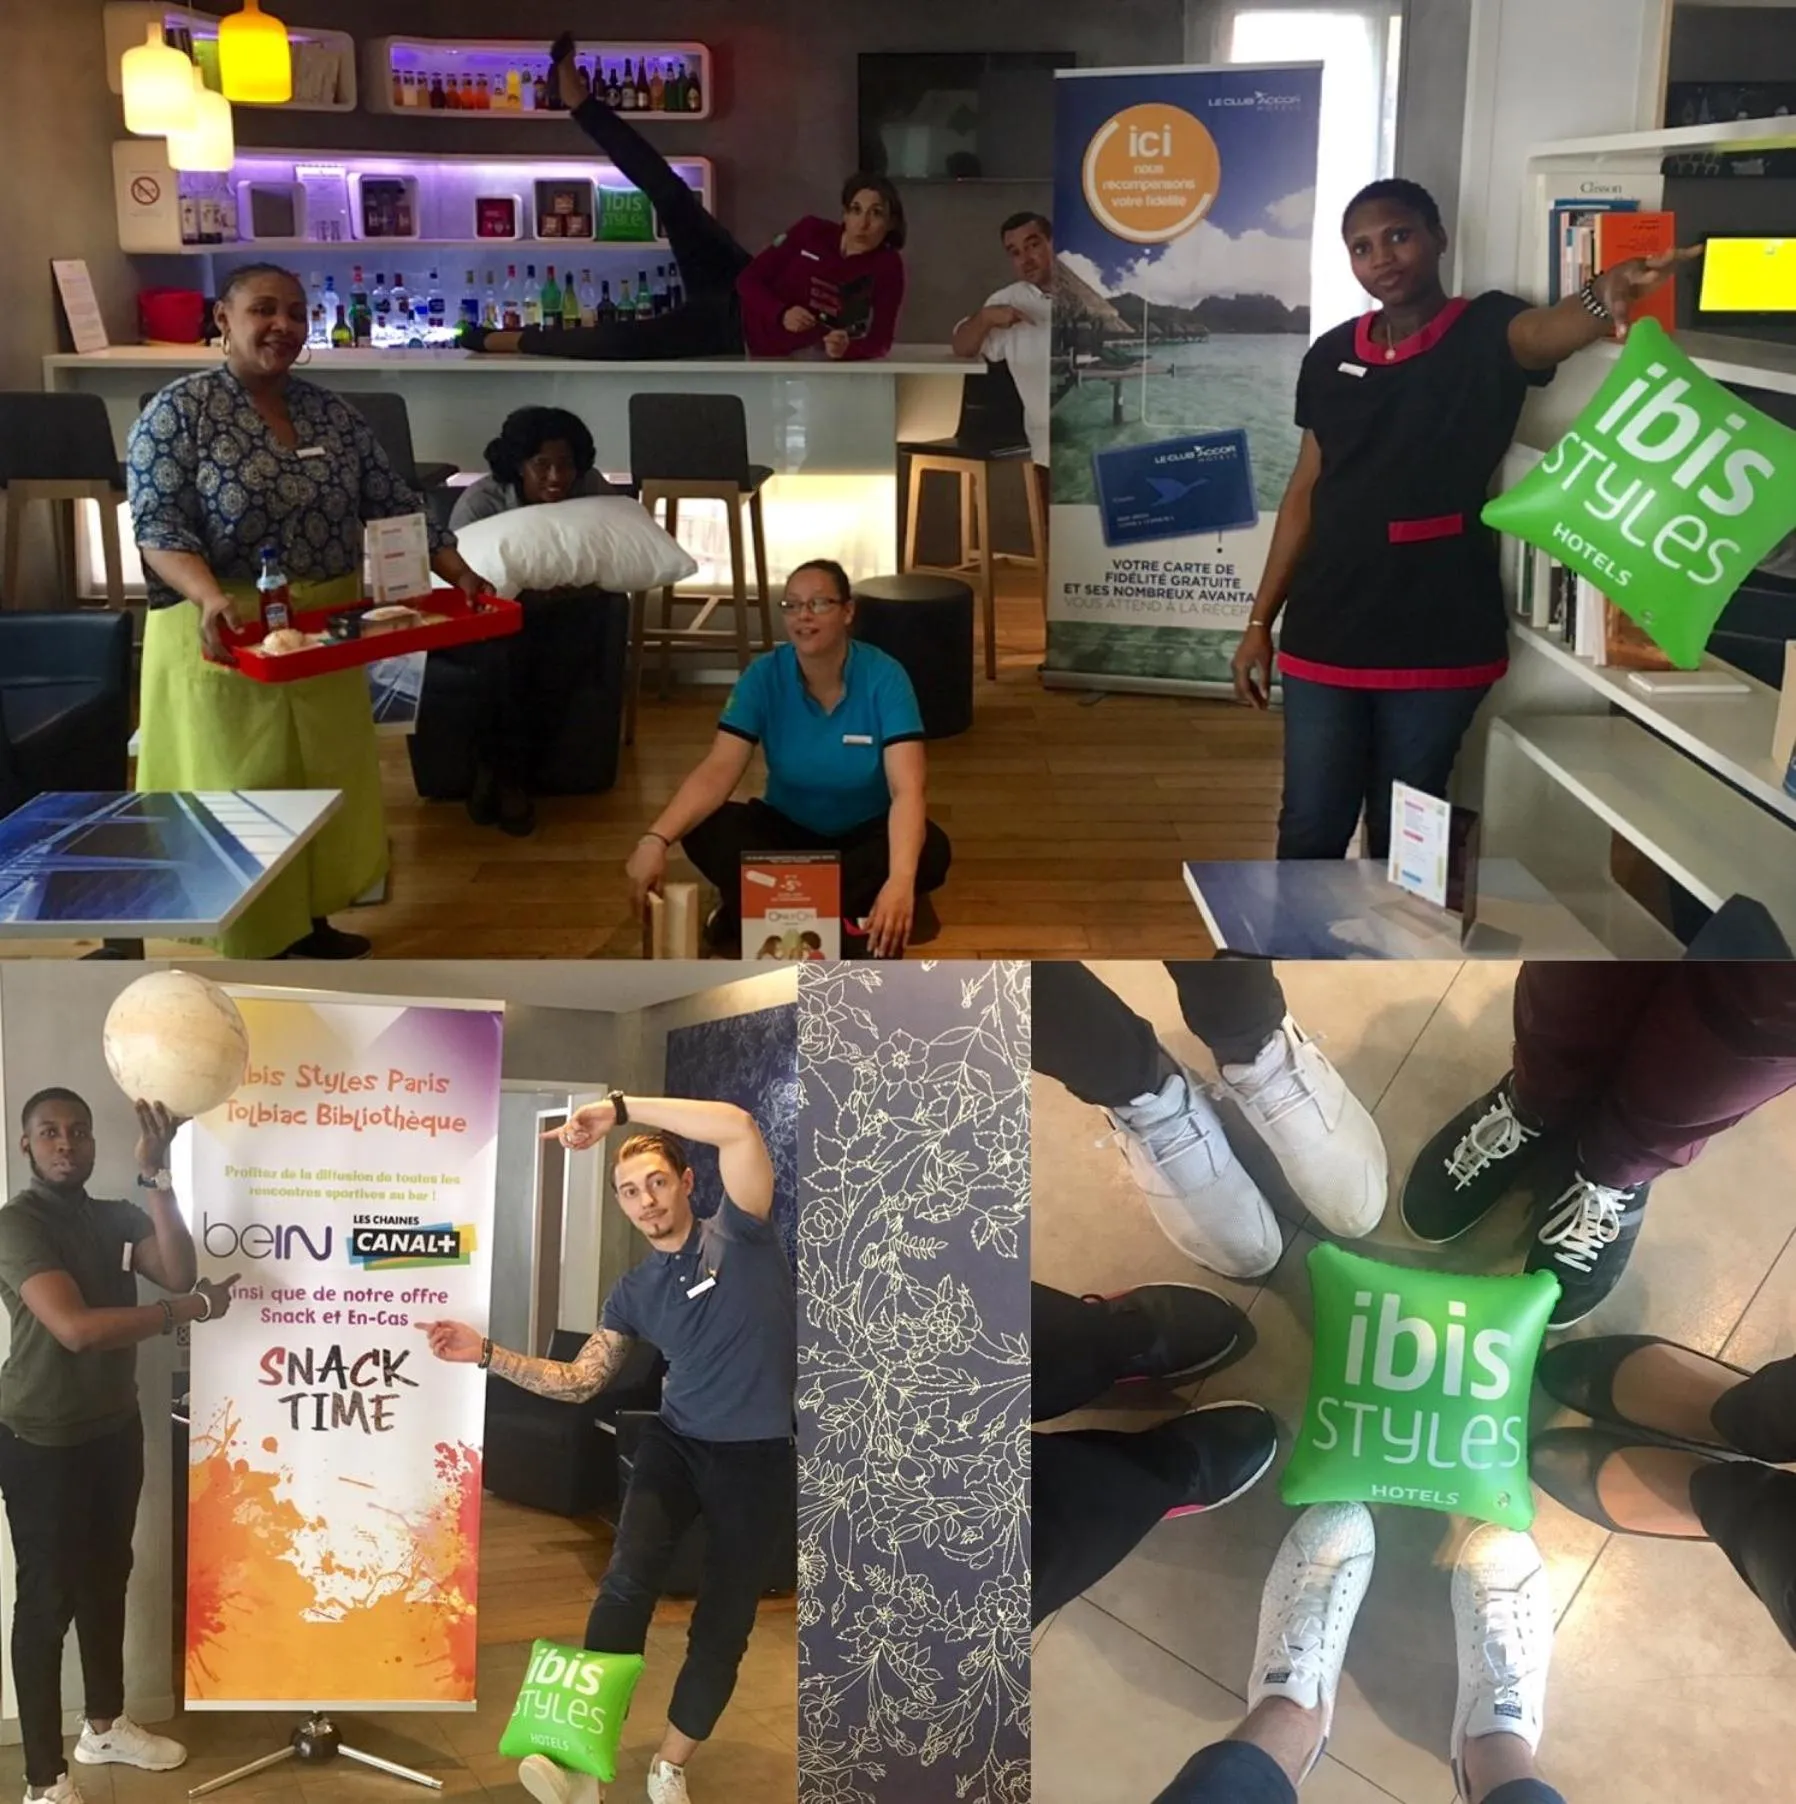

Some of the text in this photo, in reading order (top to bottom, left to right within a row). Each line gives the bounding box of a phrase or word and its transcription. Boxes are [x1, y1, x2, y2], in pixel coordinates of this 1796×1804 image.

[1129, 123, 1172, 158] ici
[1133, 164, 1164, 175] nous
[1111, 195, 1144, 208] votre
[1594, 362, 1776, 517] ibis
[1552, 521, 1633, 587] HOTELS
[1112, 559, 1235, 576] VOTRE CARTE DE
[1170, 574, 1241, 589] GRATUITE
[1063, 583, 1257, 603] ET SES NOMBREUX AVANTA
[1064, 596, 1103, 609] VOUS
[1105, 598, 1162, 613] ATTEND
[1179, 603, 1200, 615] LA
[296, 1064, 378, 1094] Styles
[387, 1069, 449, 1094] Paris
[226, 1099, 467, 1137] Tolbiac Bibliothèque
[281, 1168, 296, 1179] de
[300, 1168, 312, 1180] la
[316, 1168, 373, 1182] diffusion
[376, 1171, 392, 1183] de
[396, 1172, 437, 1184] toutes
[441, 1173, 460, 1184] les
[249, 1186, 321, 1198] rencontres
[325, 1188, 386, 1200] sportives
[389, 1190, 405, 1200] au
[408, 1189, 428, 1201] bar
[353, 1215, 420, 1225] LES CHAINES
[203, 1211, 333, 1261] beIN
[356, 1231, 456, 1253] CANAL+
[232, 1285, 449, 1304] insi que de notre offre
[260, 1308, 409, 1326] Snack et En-Cas
[1345, 1291, 1513, 1400] ibis
[258, 1345, 420, 1390] SNACK
[278, 1391, 401, 1434] TIME
[1371, 1484, 1460, 1506] HOTELS
[527, 1649, 604, 1695] ibis
[529, 1732, 570, 1751] HOTELS
